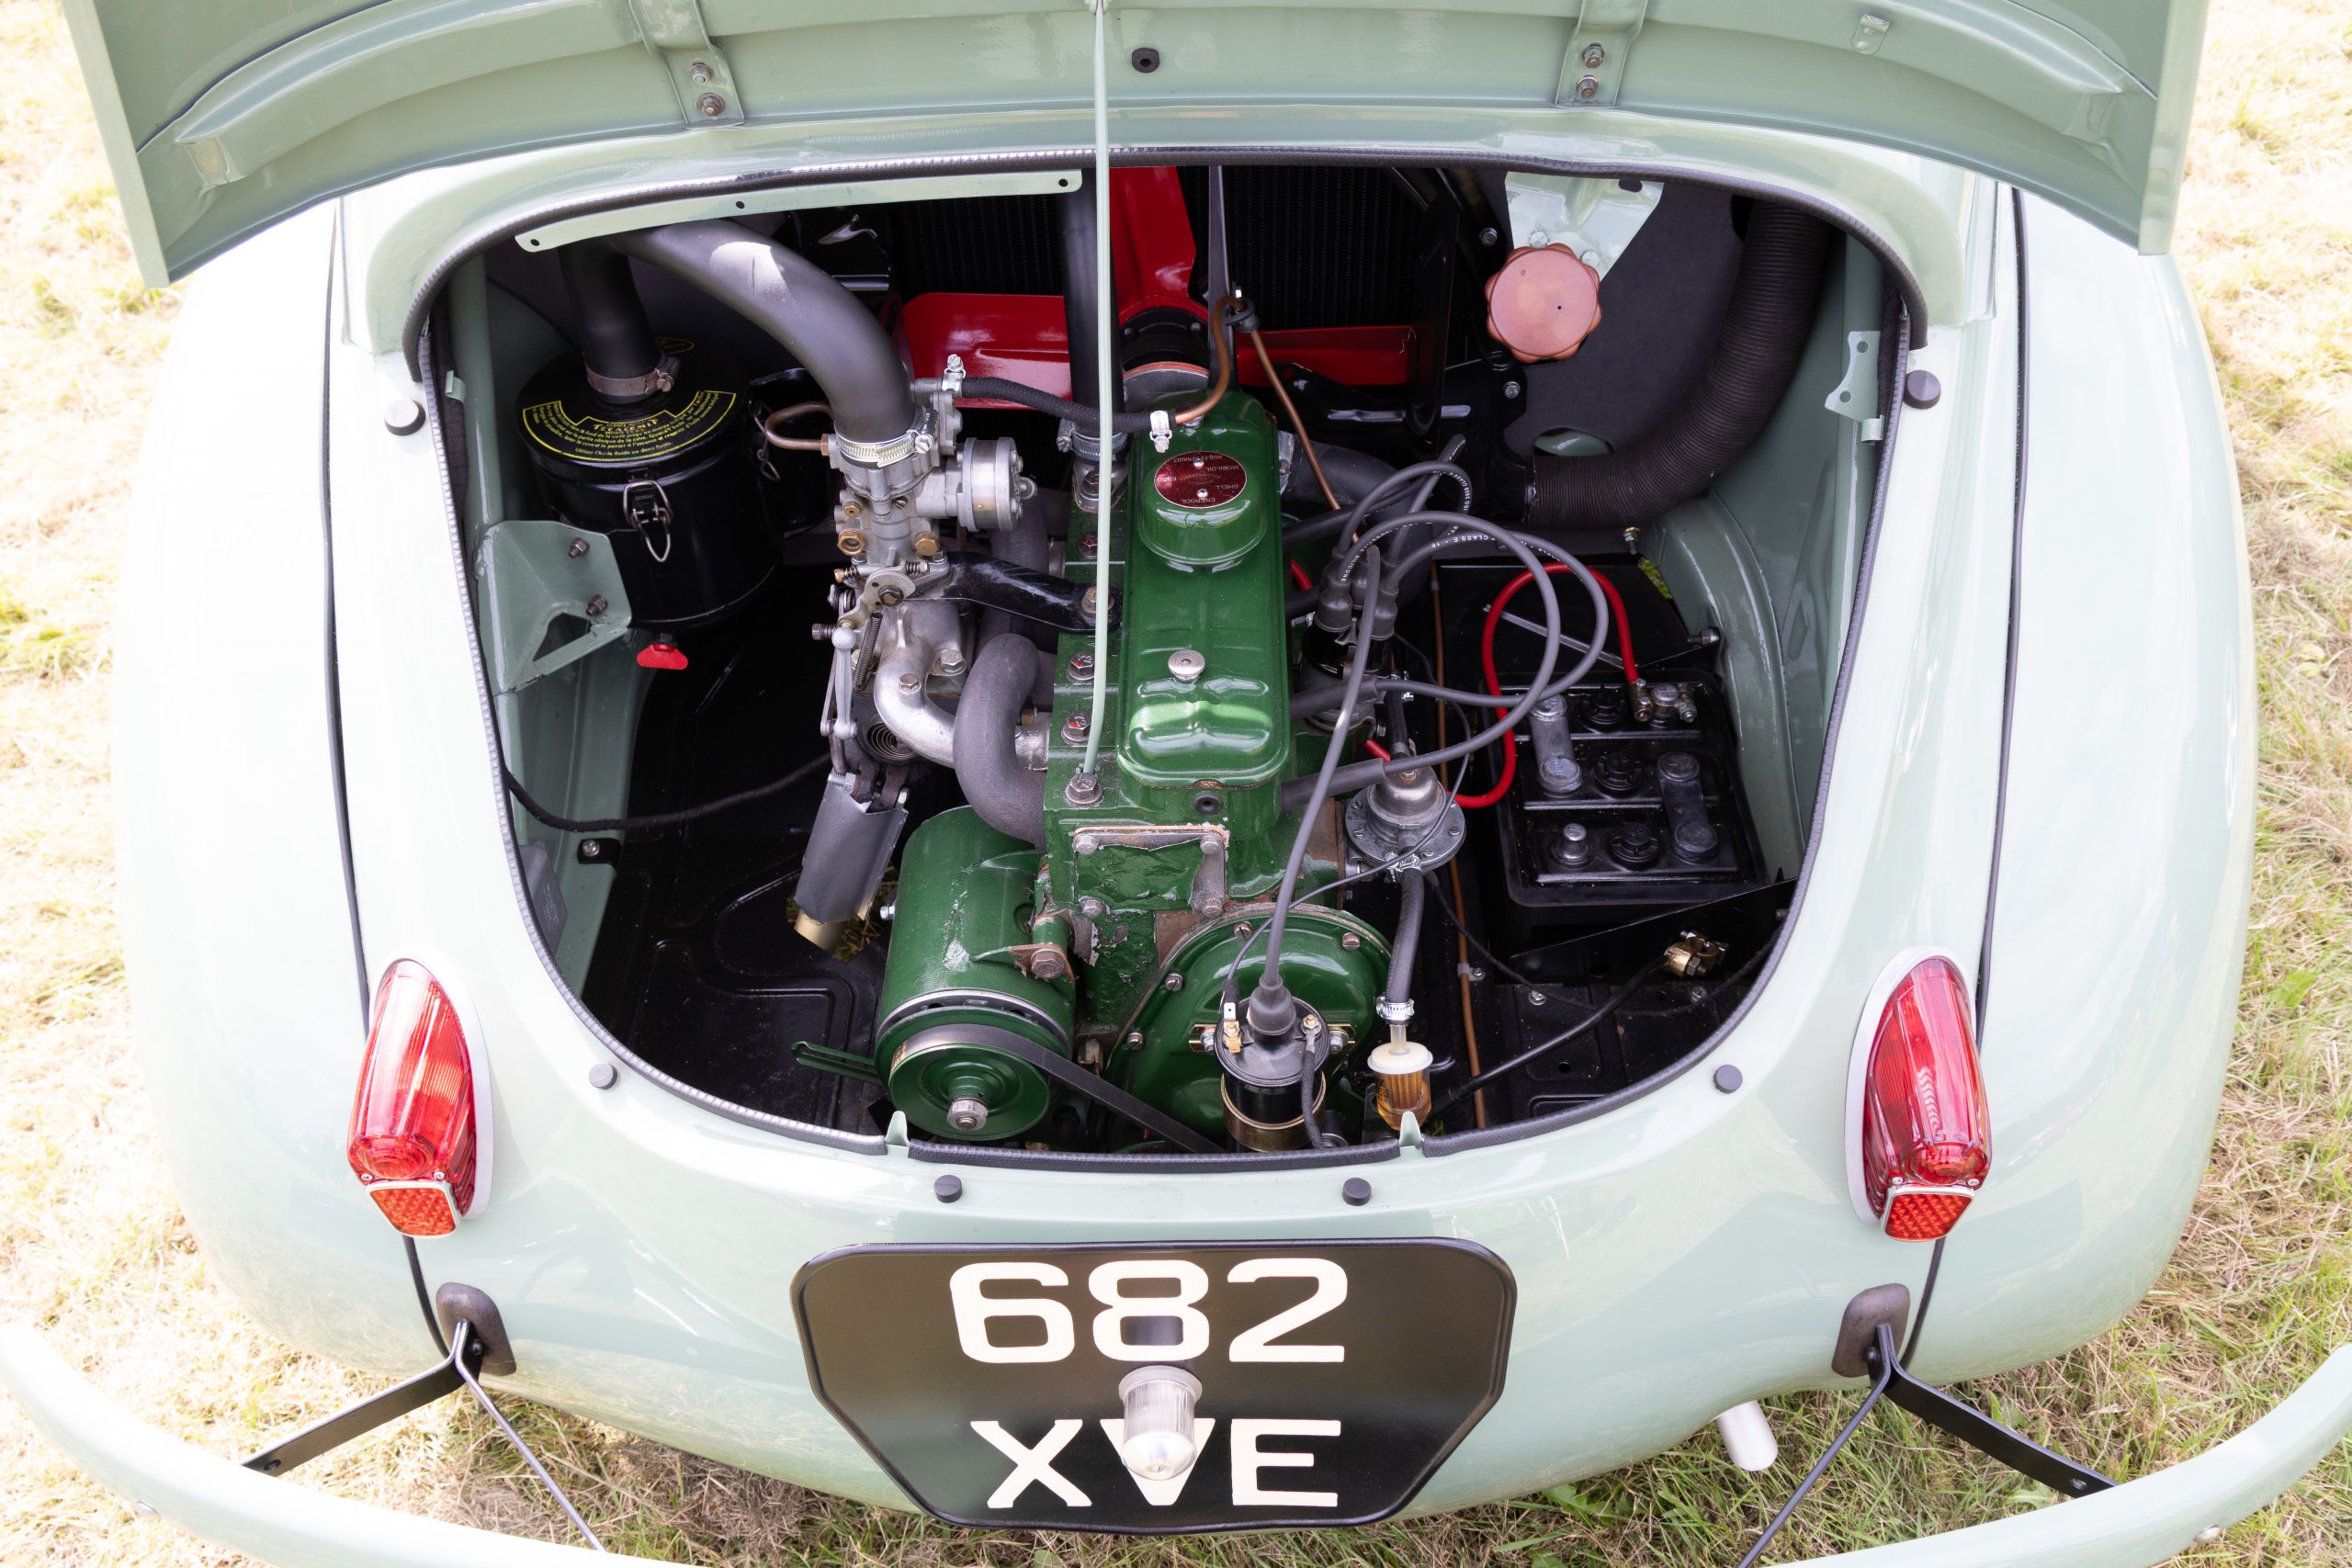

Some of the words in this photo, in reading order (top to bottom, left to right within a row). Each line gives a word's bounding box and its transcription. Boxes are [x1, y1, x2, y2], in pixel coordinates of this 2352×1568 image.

[1340, 554, 1360, 582] SILICONE
[950, 1258, 1348, 1363] 682
[970, 1418, 1341, 1508] XVE
